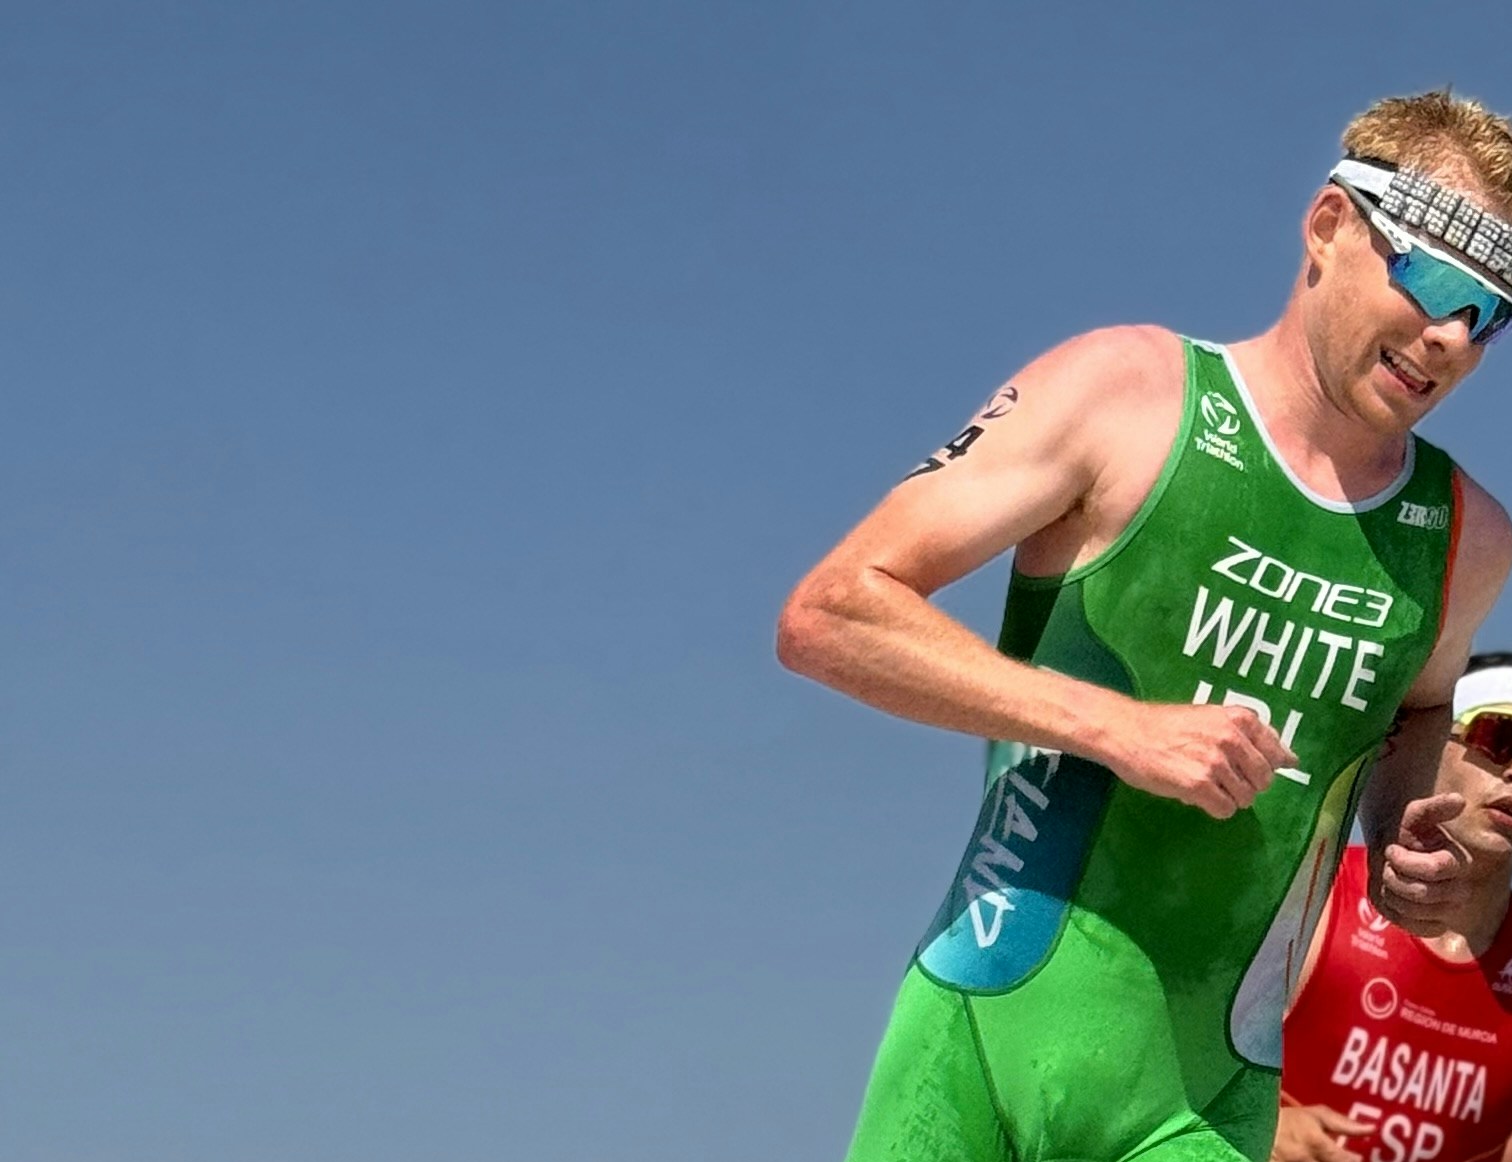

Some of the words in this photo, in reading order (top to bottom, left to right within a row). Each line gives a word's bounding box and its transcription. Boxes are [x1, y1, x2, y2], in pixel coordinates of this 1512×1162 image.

[1211, 535, 1394, 628] ZONE3
[1182, 585, 1385, 712] WHITE
[1330, 1026, 1487, 1124] BASANTA
